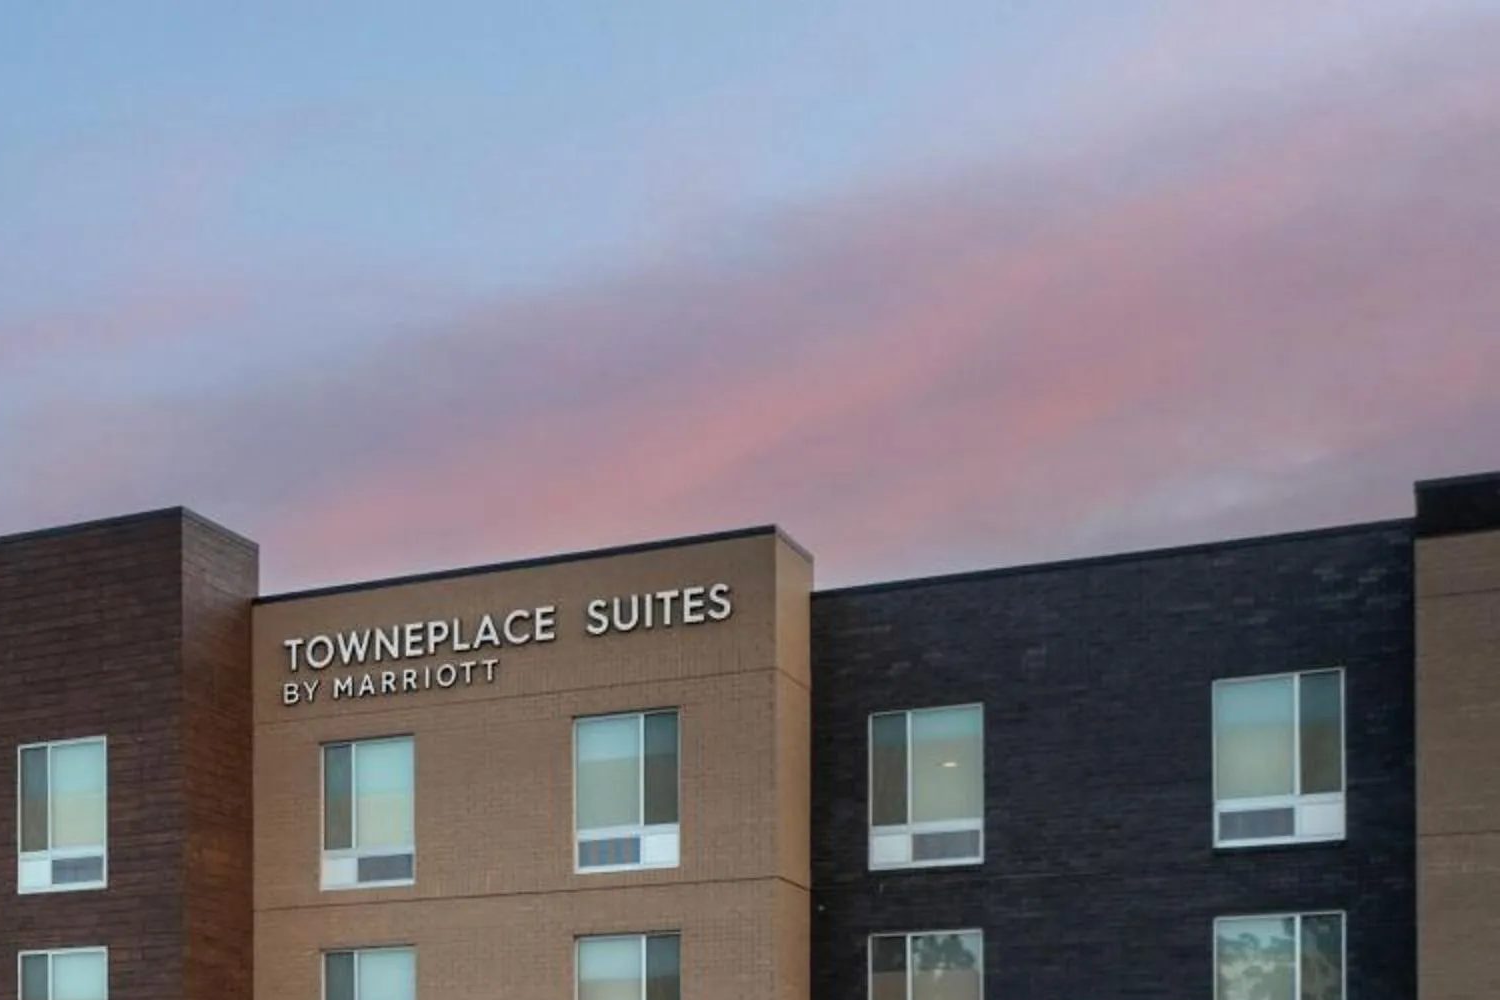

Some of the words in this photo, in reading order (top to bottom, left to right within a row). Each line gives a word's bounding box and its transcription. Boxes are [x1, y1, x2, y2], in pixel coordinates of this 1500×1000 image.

[284, 606, 556, 671] TOWNEPLACE
[586, 583, 732, 635] SUITES
[283, 682, 318, 704] BY
[333, 659, 499, 699] MARRIOTT
